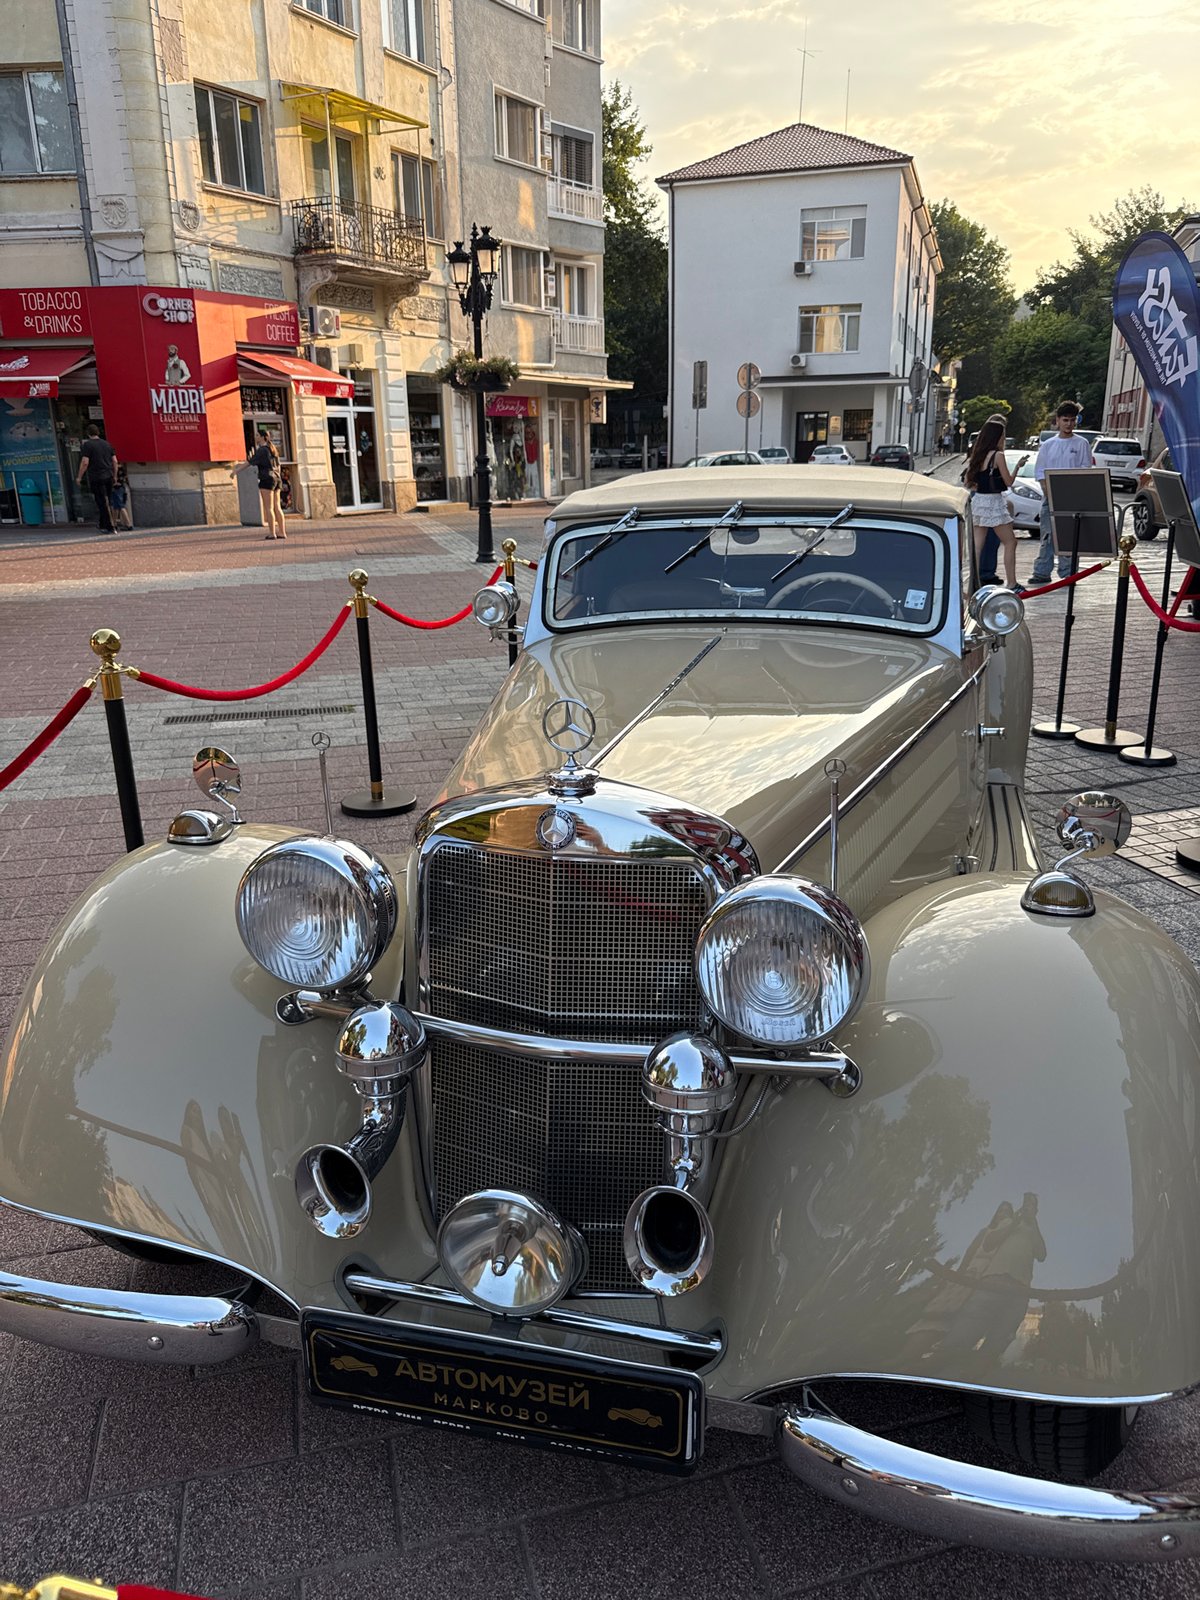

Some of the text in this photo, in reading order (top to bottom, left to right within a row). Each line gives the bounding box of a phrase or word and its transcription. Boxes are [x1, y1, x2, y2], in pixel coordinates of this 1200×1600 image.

[18, 291, 82, 311] TOBACCO
[143, 292, 194, 317] CORNER
[163, 310, 195, 324] SHOP
[266, 324, 296, 343] COFFEE
[150, 386, 207, 414] MADRÍ
[394, 1359, 590, 1411] АВТОМУЗЕЙ
[434, 1391, 549, 1425] МАРКОВО
